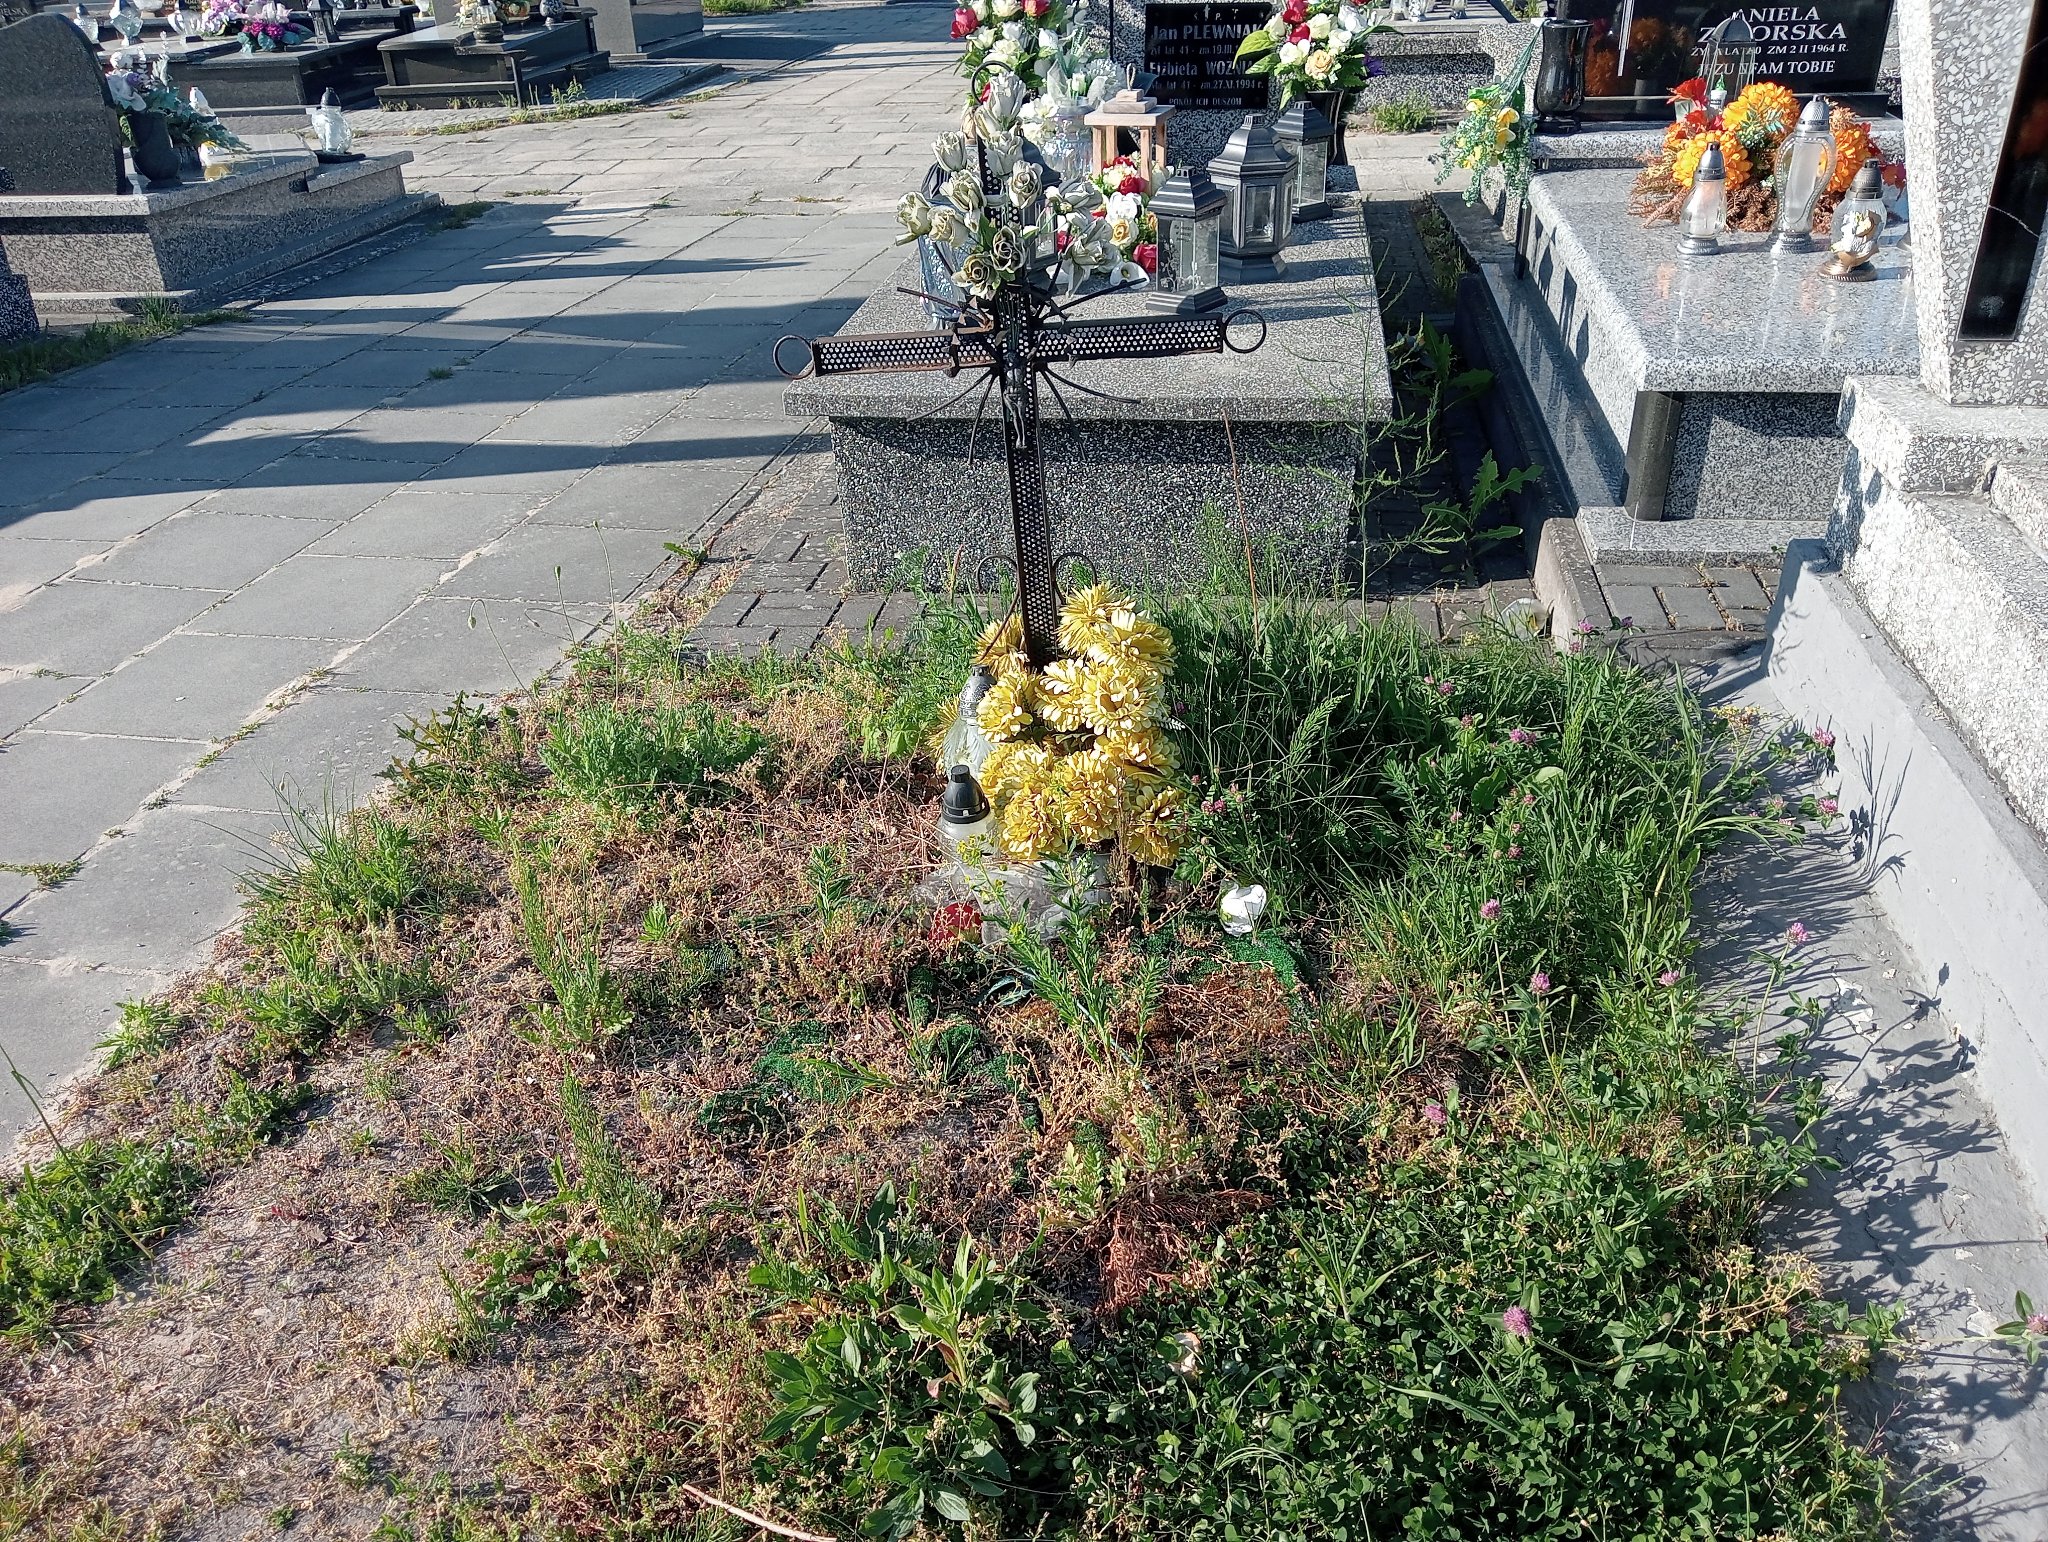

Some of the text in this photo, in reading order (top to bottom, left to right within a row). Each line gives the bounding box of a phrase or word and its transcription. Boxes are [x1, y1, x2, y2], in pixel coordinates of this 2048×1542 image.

[1151, 25, 1178, 40] Jan
[1697, 22, 1847, 43] ZORSKA
[1767, 46, 1788, 55] ZM
[1790, 46, 1798, 54] 2
[1799, 45, 1809, 54] II
[1811, 44, 1835, 53] 1964
[1149, 61, 1198, 77] Elżbieta
[1787, 60, 1836, 74] TOBIE
